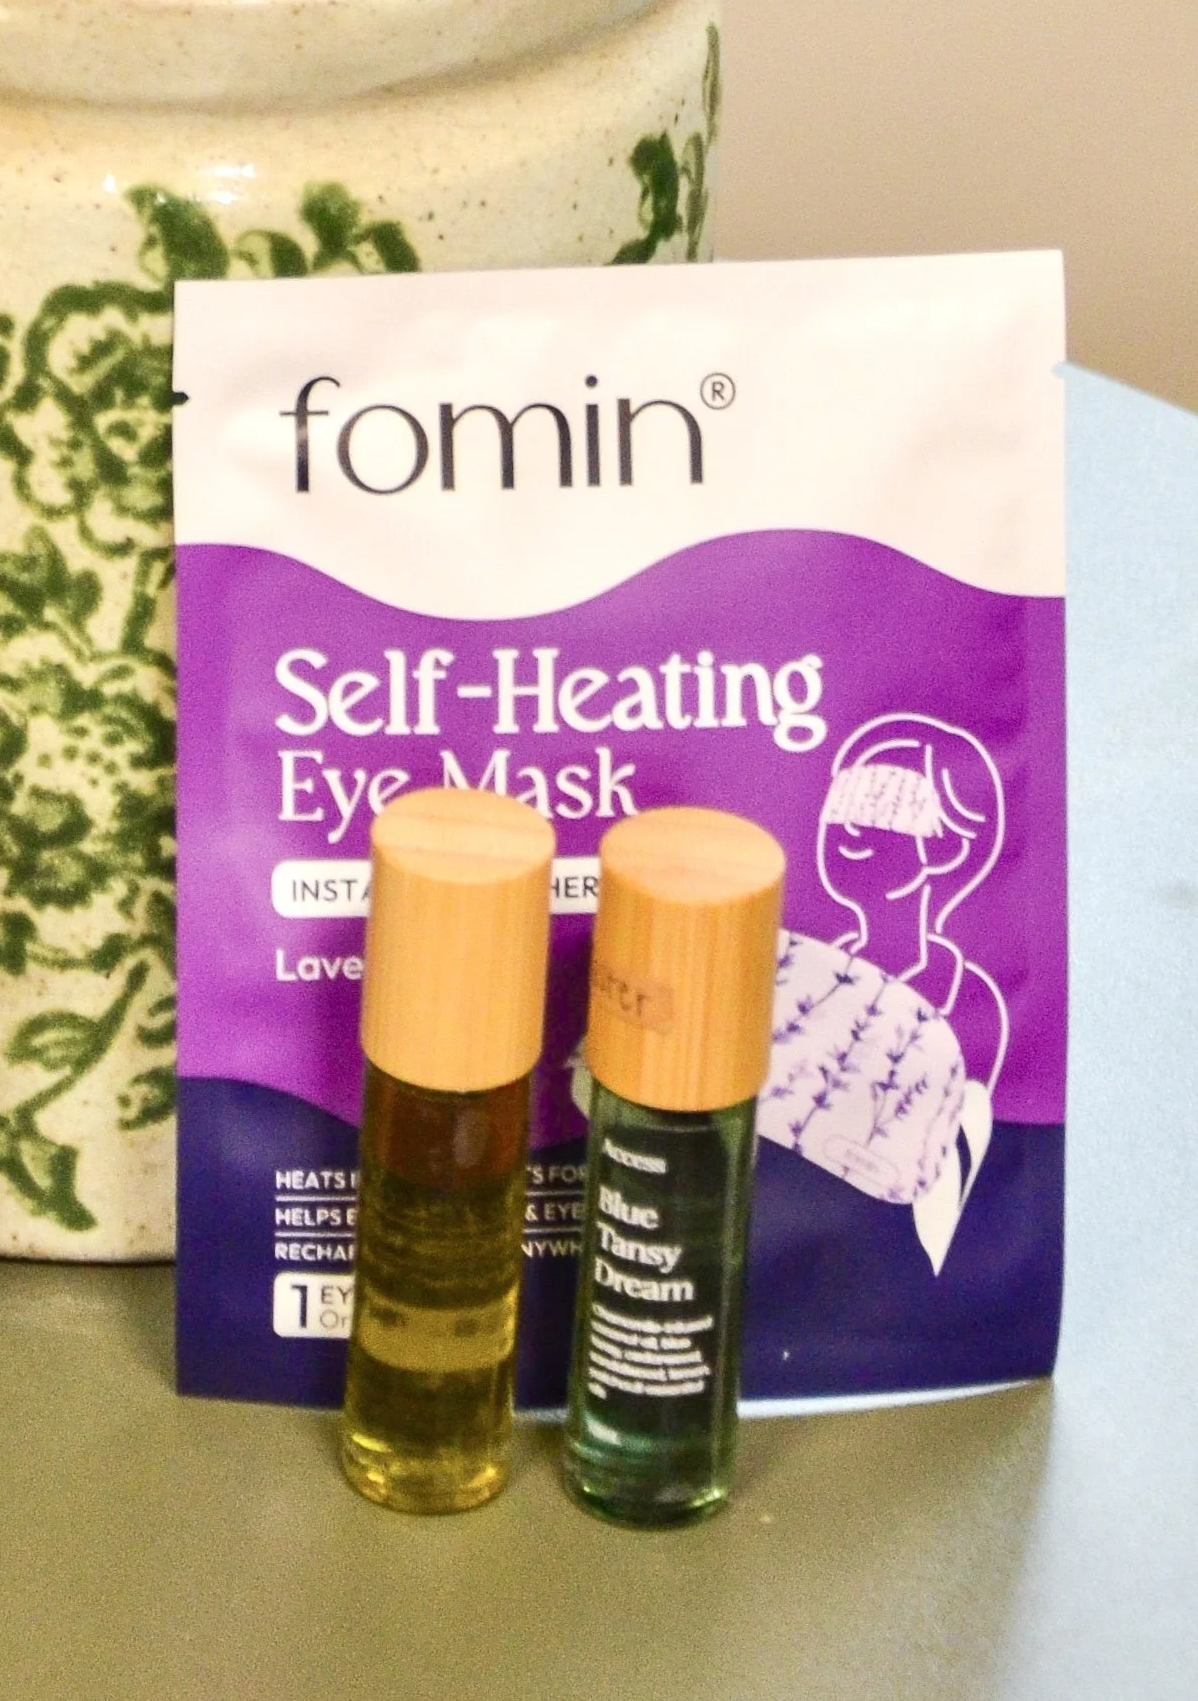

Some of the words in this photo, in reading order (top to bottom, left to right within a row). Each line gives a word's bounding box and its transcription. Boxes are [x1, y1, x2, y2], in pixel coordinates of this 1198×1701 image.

[274, 648, 829, 753] Self-Heating
[277, 749, 409, 844] Eye
[438, 746, 639, 820] Mask
[275, 947, 365, 981] Lave
[275, 1170, 347, 1190] HEATS
[275, 1207, 342, 1227] HELPS
[598, 1184, 660, 1230] Blue
[596, 1219, 683, 1275] Tansy
[594, 1255, 696, 1303] Dream
[290, 1284, 308, 1329] 1
